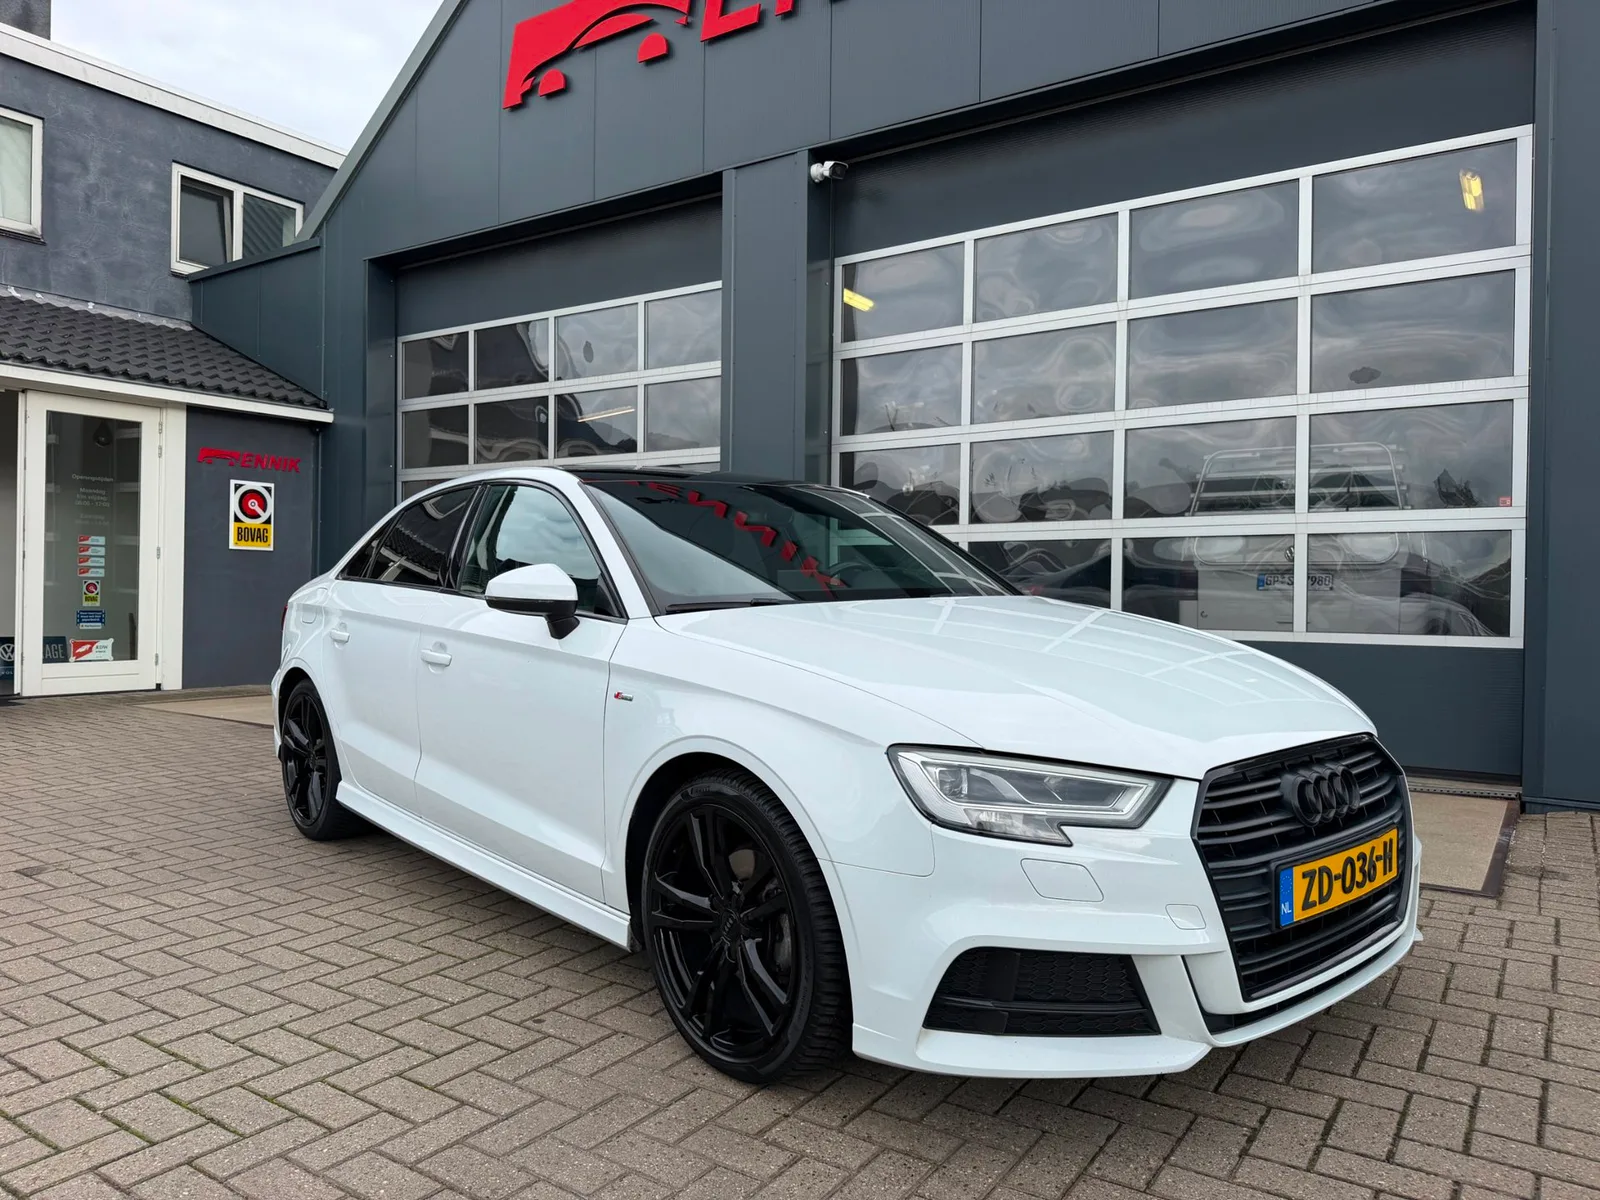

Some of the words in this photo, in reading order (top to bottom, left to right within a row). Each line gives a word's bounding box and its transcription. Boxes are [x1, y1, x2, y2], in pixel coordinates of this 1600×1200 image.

[236, 526, 269, 543] BOVAG
[43, 644, 65, 659] AGE
[1281, 902, 1292, 915] NL
[1302, 838, 1394, 911] ZD-036-H
